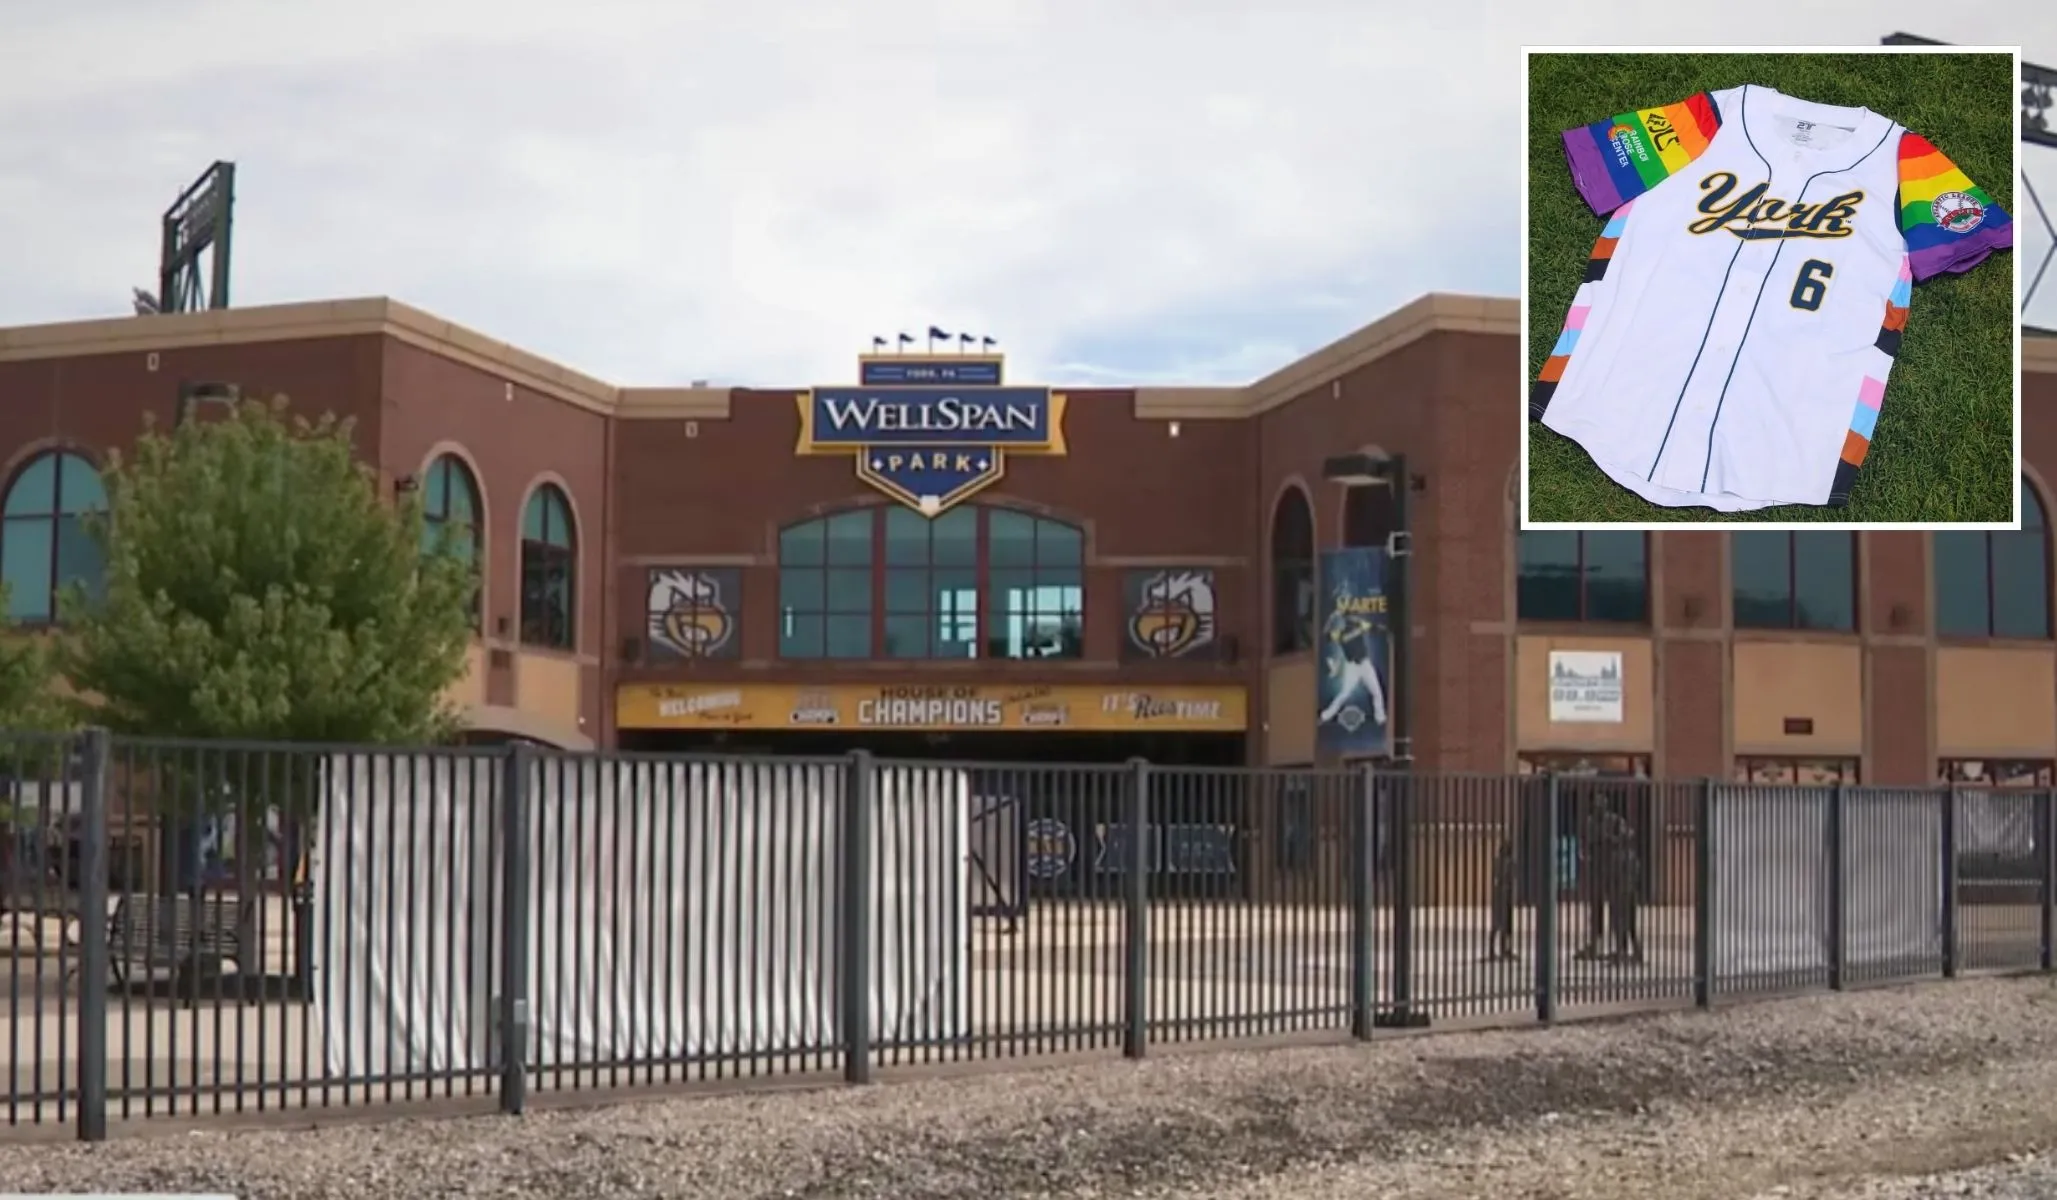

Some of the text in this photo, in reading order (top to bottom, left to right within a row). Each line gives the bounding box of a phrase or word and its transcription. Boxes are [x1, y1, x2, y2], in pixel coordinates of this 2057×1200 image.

[1687, 171, 1865, 241] York
[1789, 258, 1834, 312] 6
[889, 452, 971, 472] PARK
[1337, 595, 1388, 615] MARTE
[880, 686, 976, 699] HOUSE OF
[859, 699, 1001, 724] CHAMPIONS
[1102, 692, 1137, 712] IT'S
[1176, 701, 1221, 719] TIME
